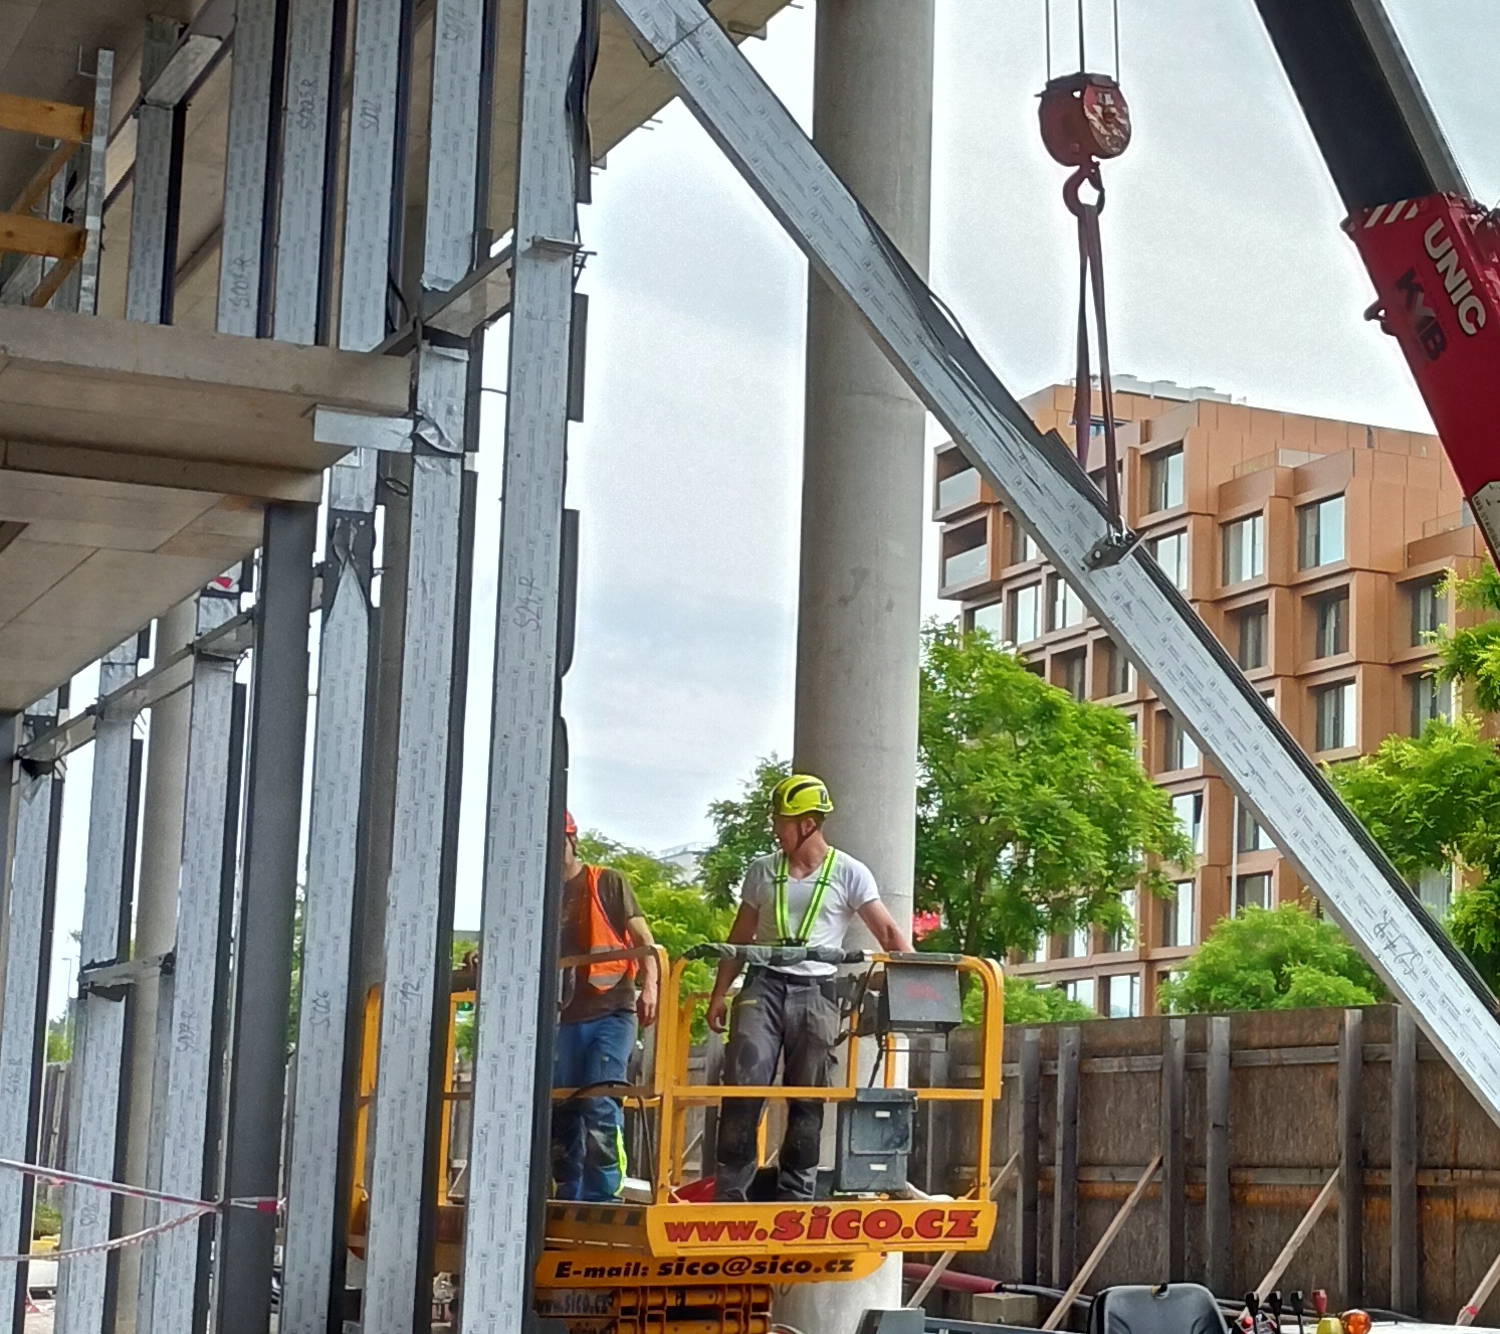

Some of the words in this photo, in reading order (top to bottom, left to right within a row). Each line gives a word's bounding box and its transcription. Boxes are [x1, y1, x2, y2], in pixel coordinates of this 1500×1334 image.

[1425, 220, 1486, 335] UNIC
[663, 1206, 982, 1244] www.sico.cz
[554, 1259, 649, 1280] E-mail:
[657, 1255, 857, 1278] sico@sico.cz
